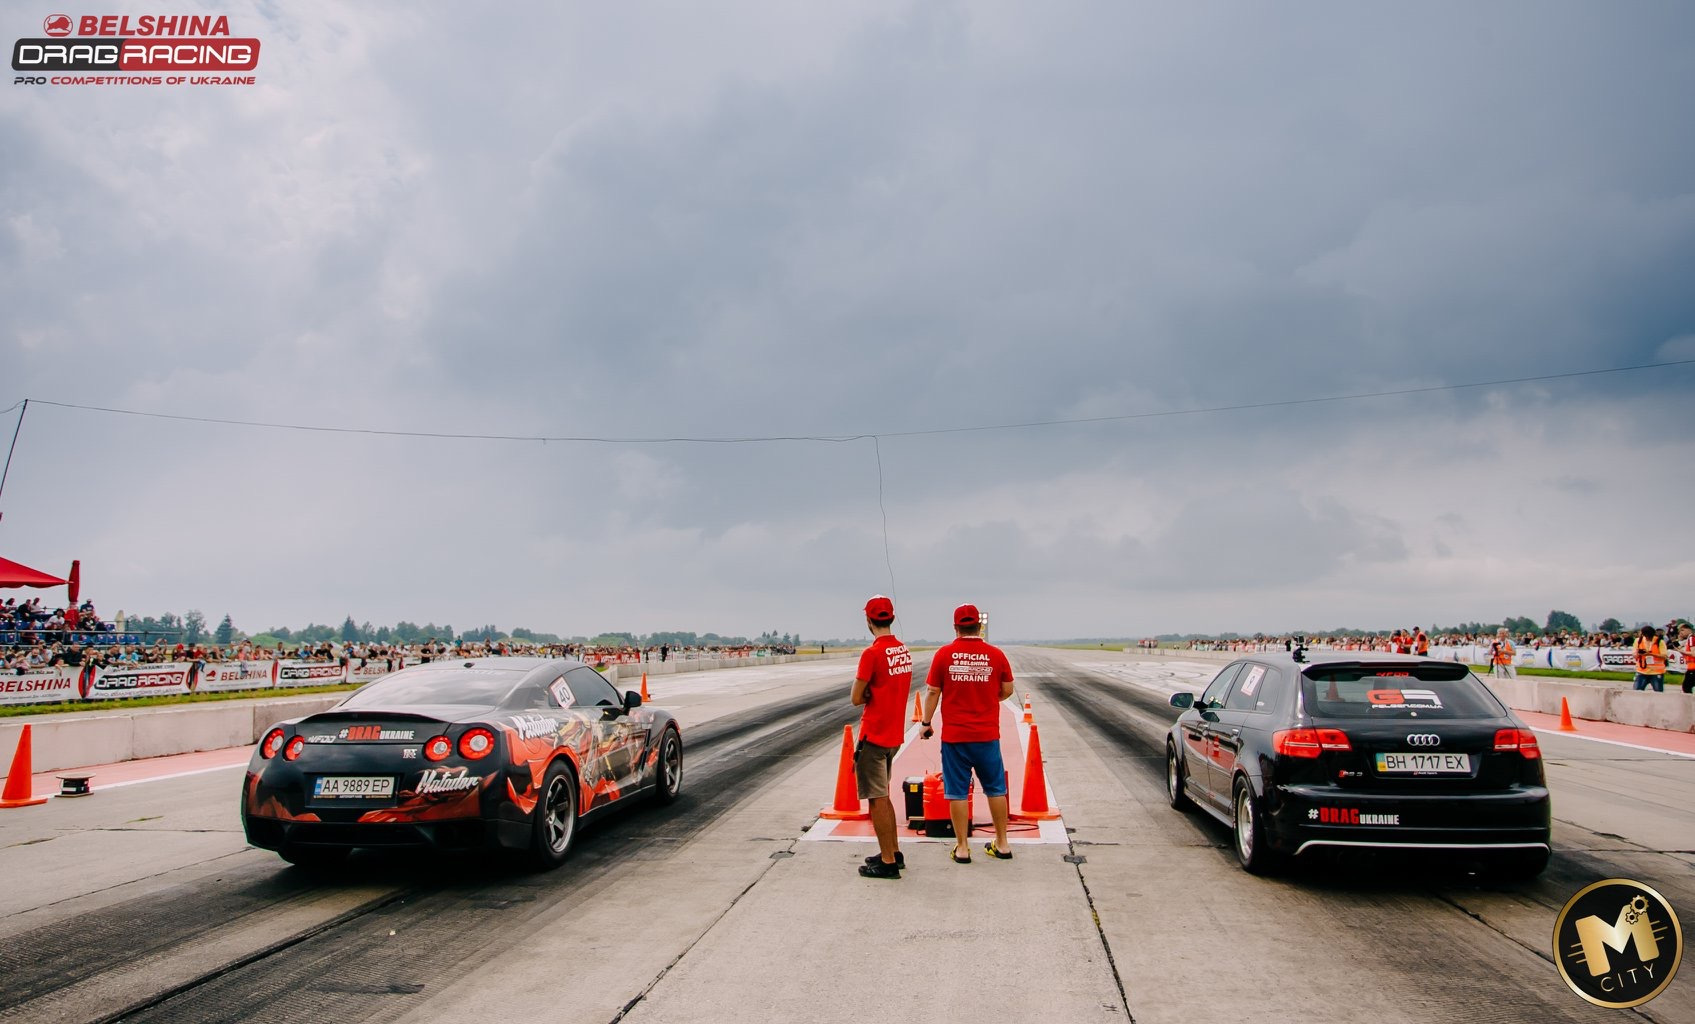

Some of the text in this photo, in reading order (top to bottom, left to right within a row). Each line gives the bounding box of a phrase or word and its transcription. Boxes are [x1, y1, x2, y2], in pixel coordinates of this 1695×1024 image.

[885, 644, 909, 655] OFFICIA
[952, 652, 990, 661] OFFICIAL
[888, 664, 912, 676] UKRAIN
[951, 674, 989, 682] UKRAINE
[559, 686, 571, 703] 40
[1386, 755, 1465, 769] BH 1717 EX
[323, 779, 390, 793] AA 9889 EP
[415, 770, 480, 794] Matador
